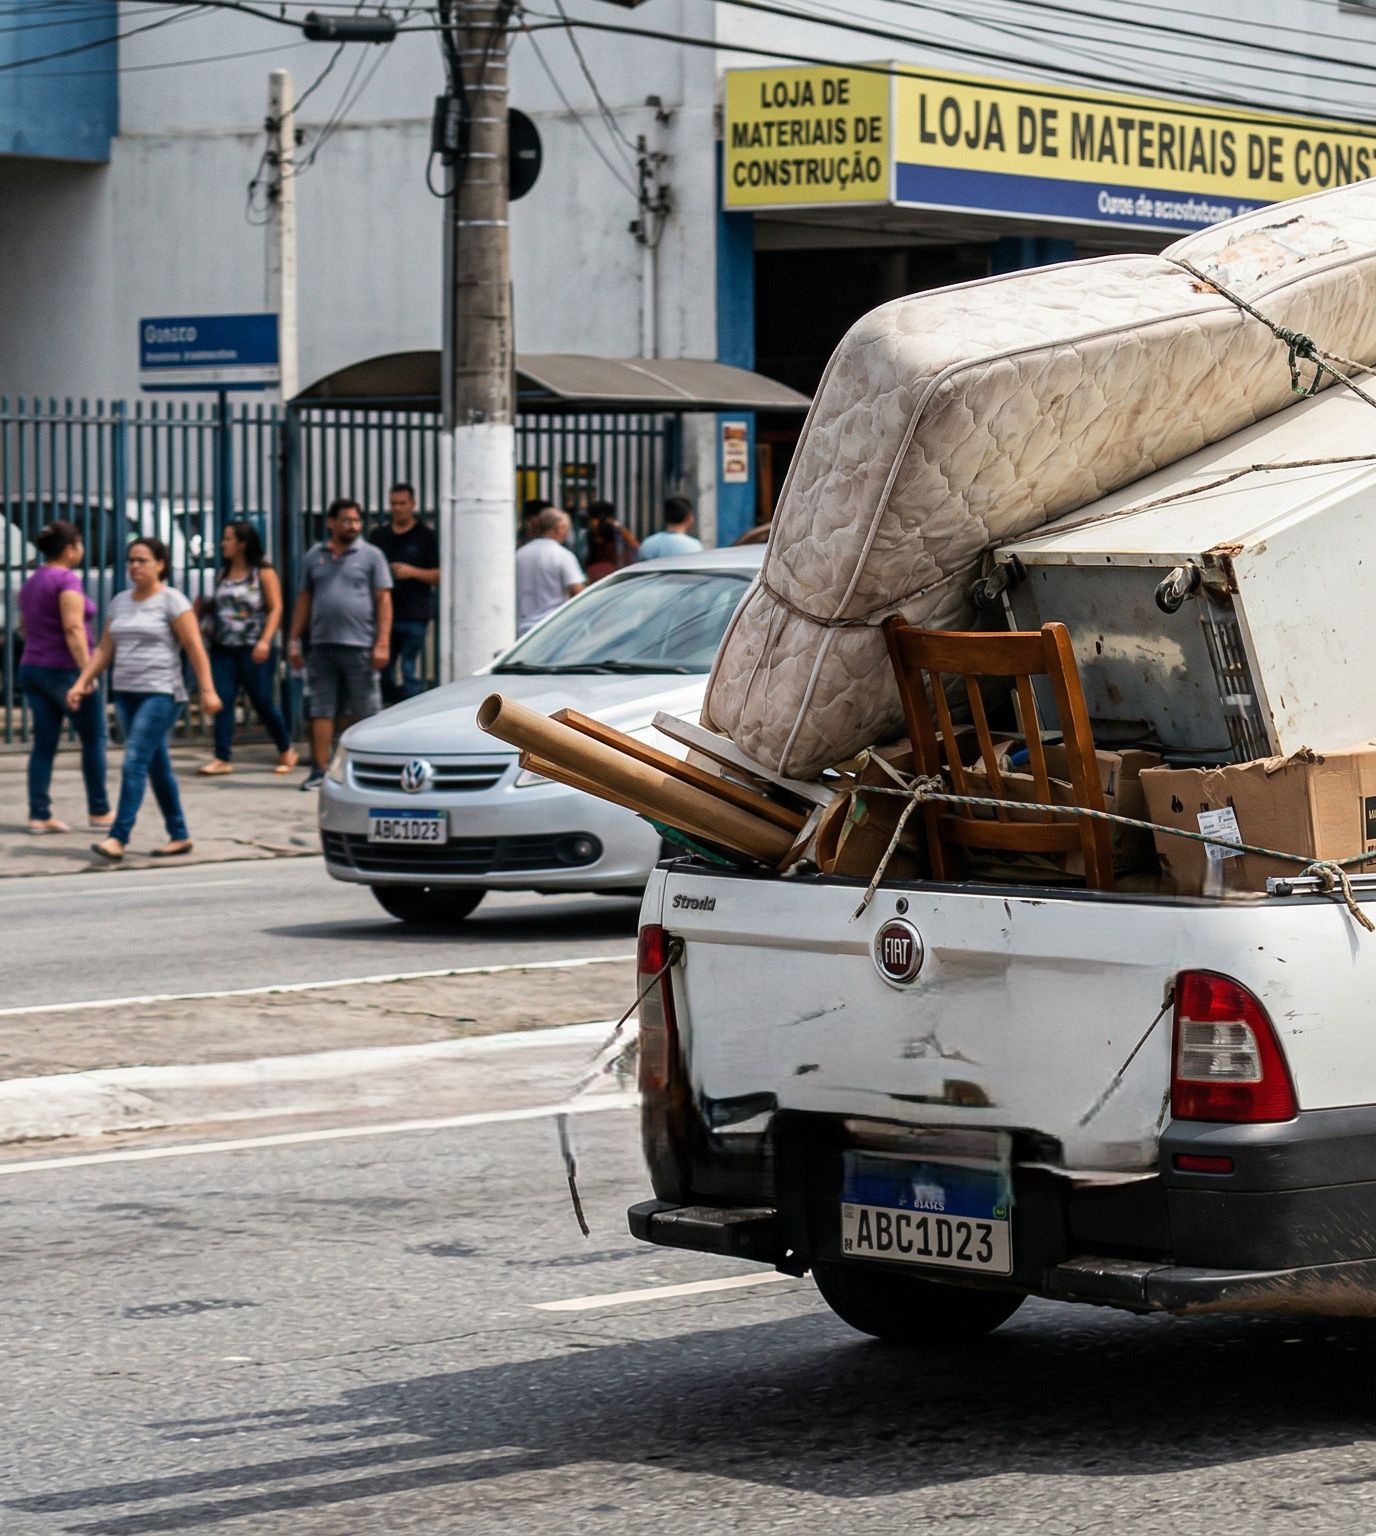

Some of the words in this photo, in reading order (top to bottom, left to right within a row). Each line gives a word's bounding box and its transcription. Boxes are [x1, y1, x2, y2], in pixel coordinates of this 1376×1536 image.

[761, 80, 815, 109] LOJA
[822, 78, 849, 106] DE
[732, 117, 847, 148] MATERIAIS
[854, 116, 882, 143] DE
[919, 93, 1005, 152] LOJA
[1017, 105, 1058, 157] DE
[1071, 111, 1236, 178] MATERIAIS
[1247, 133, 1284, 182] DE
[733, 150, 881, 191] CONSTRUÇÃO
[885, 937, 910, 965] FIAT
[856, 1208, 994, 1264] ABC1D23
